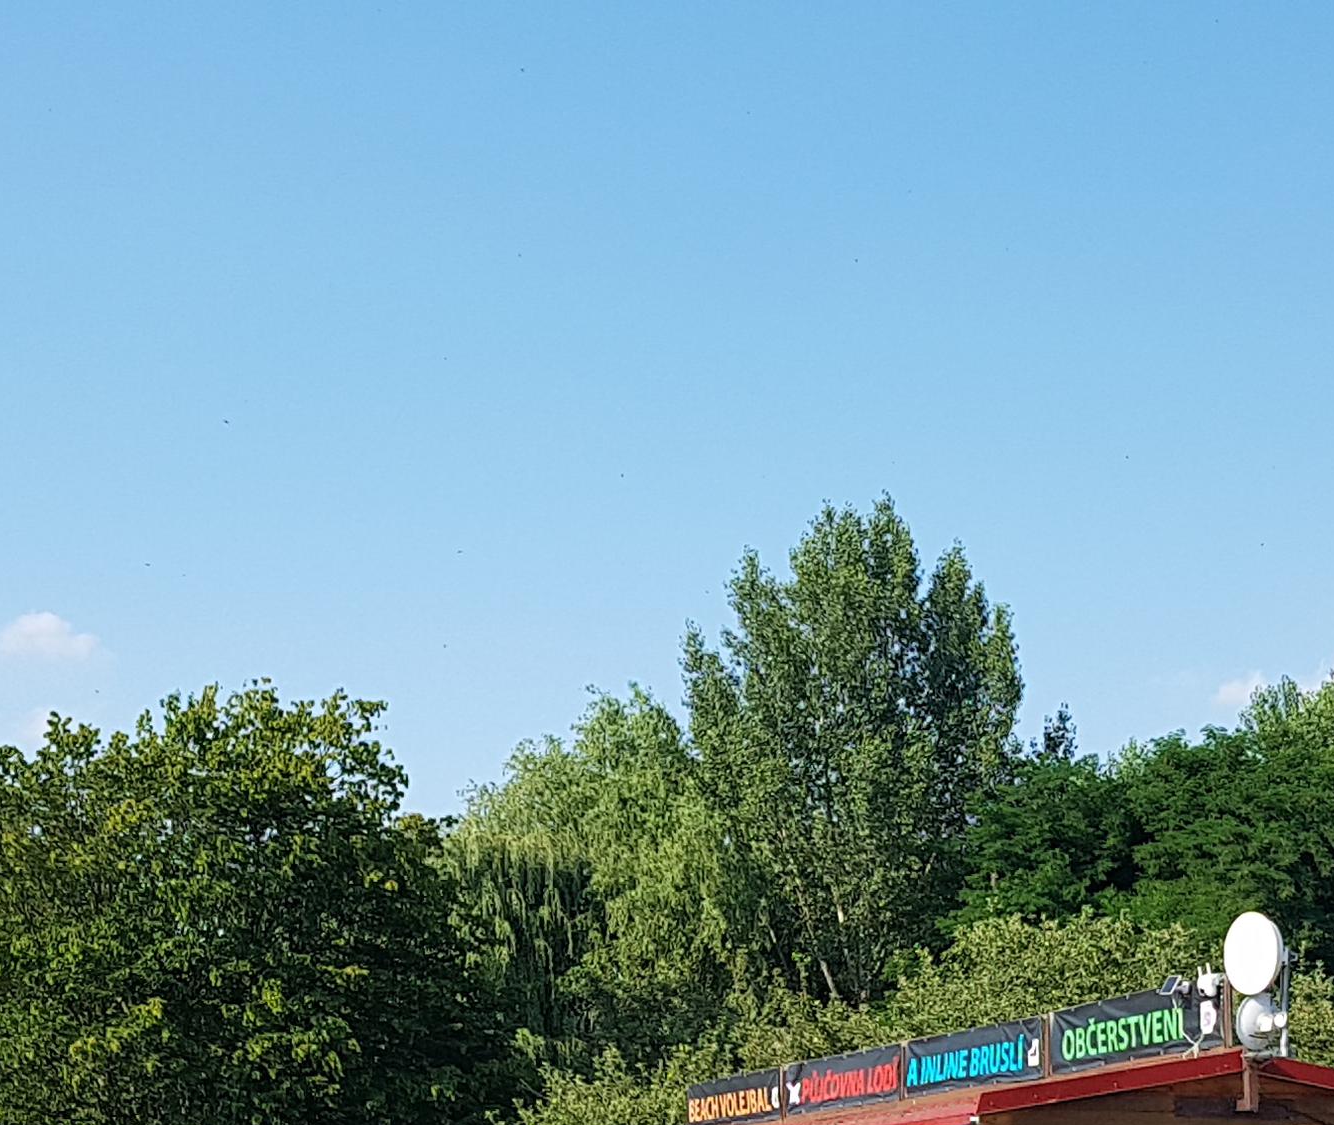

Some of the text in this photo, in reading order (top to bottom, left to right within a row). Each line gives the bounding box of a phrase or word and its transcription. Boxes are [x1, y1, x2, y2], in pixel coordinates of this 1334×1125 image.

[907, 1033, 1025, 1087] A INLINE BRUSLÍ
[688, 1086, 772, 1123] BEACH VOLEJBAL
